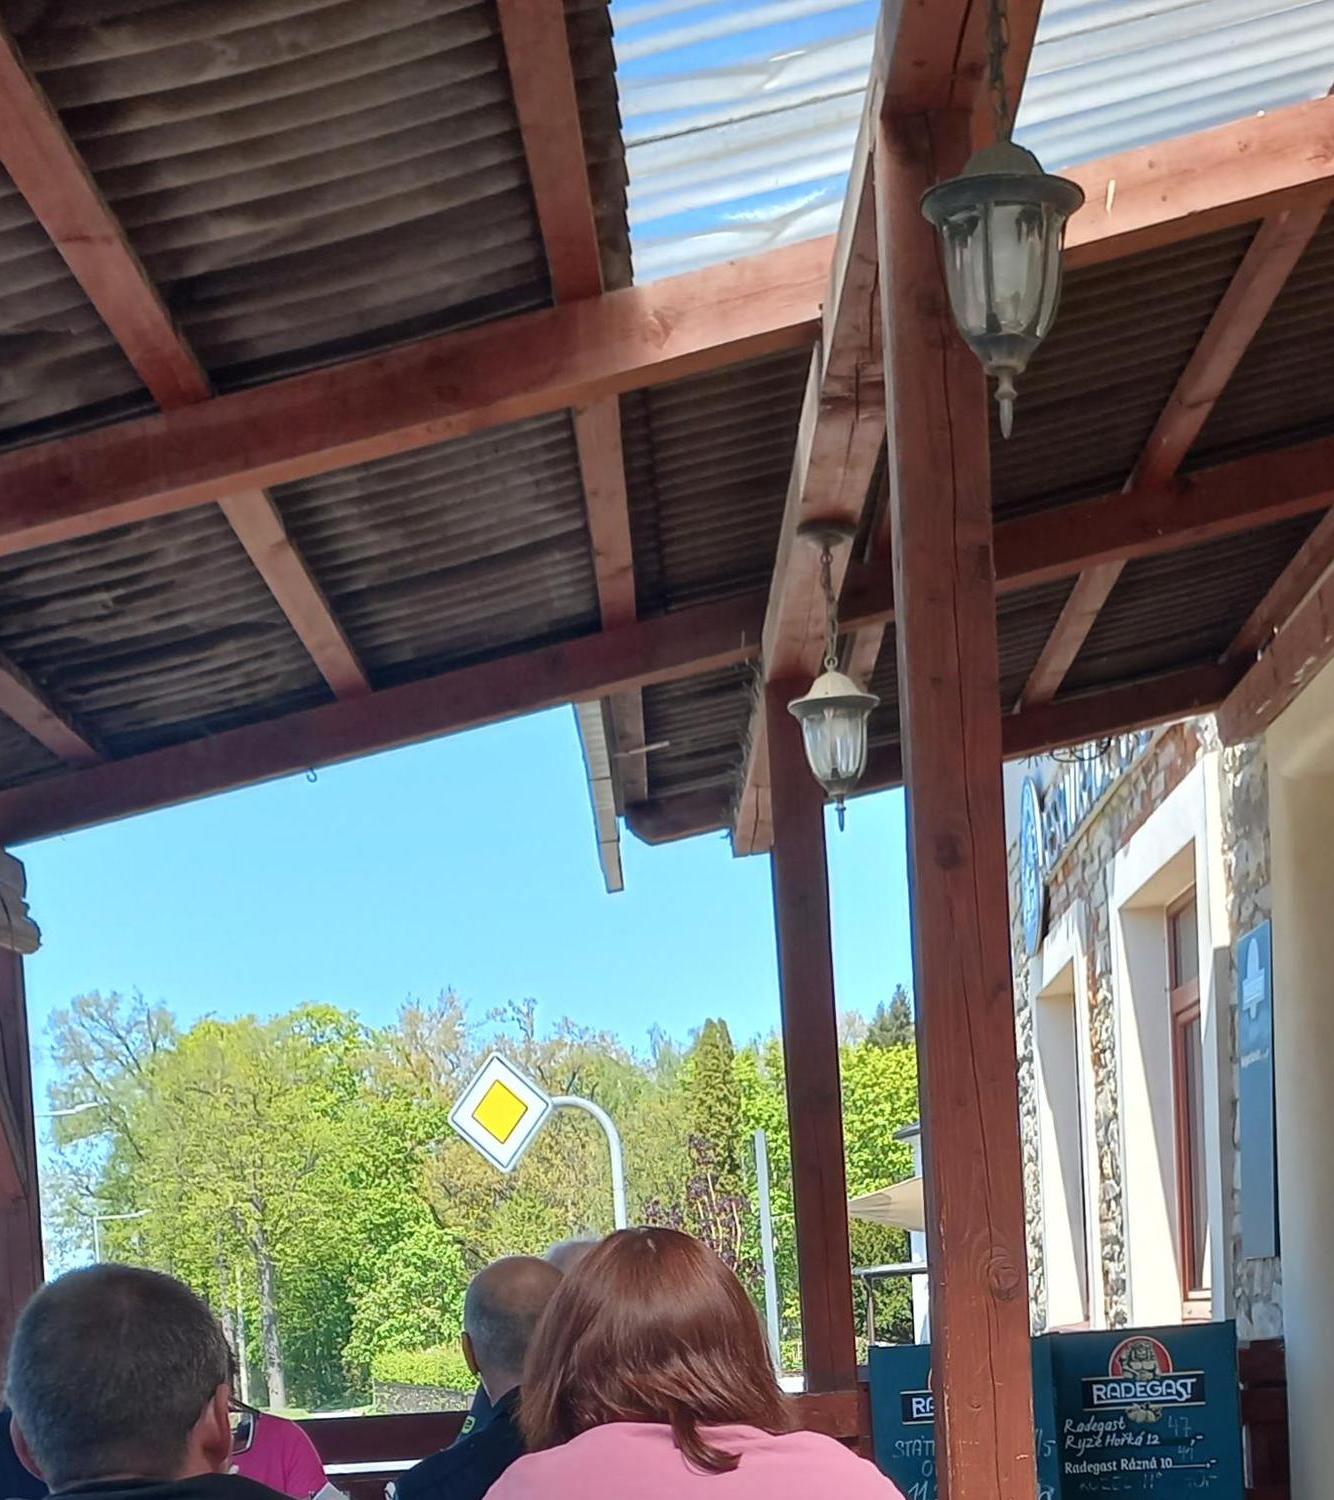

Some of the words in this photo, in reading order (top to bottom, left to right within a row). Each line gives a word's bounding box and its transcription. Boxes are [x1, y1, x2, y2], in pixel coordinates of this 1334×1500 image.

[1092, 1378, 1197, 1405] RADEGAST
[1064, 1416, 1126, 1438] Radegast
[1105, 1430, 1144, 1447] Hořká
[1146, 1432, 1161, 1445] 12
[1065, 1460, 1117, 1476] Radegast
[1120, 1457, 1158, 1470] Rázná
[1160, 1457, 1173, 1469] 10
